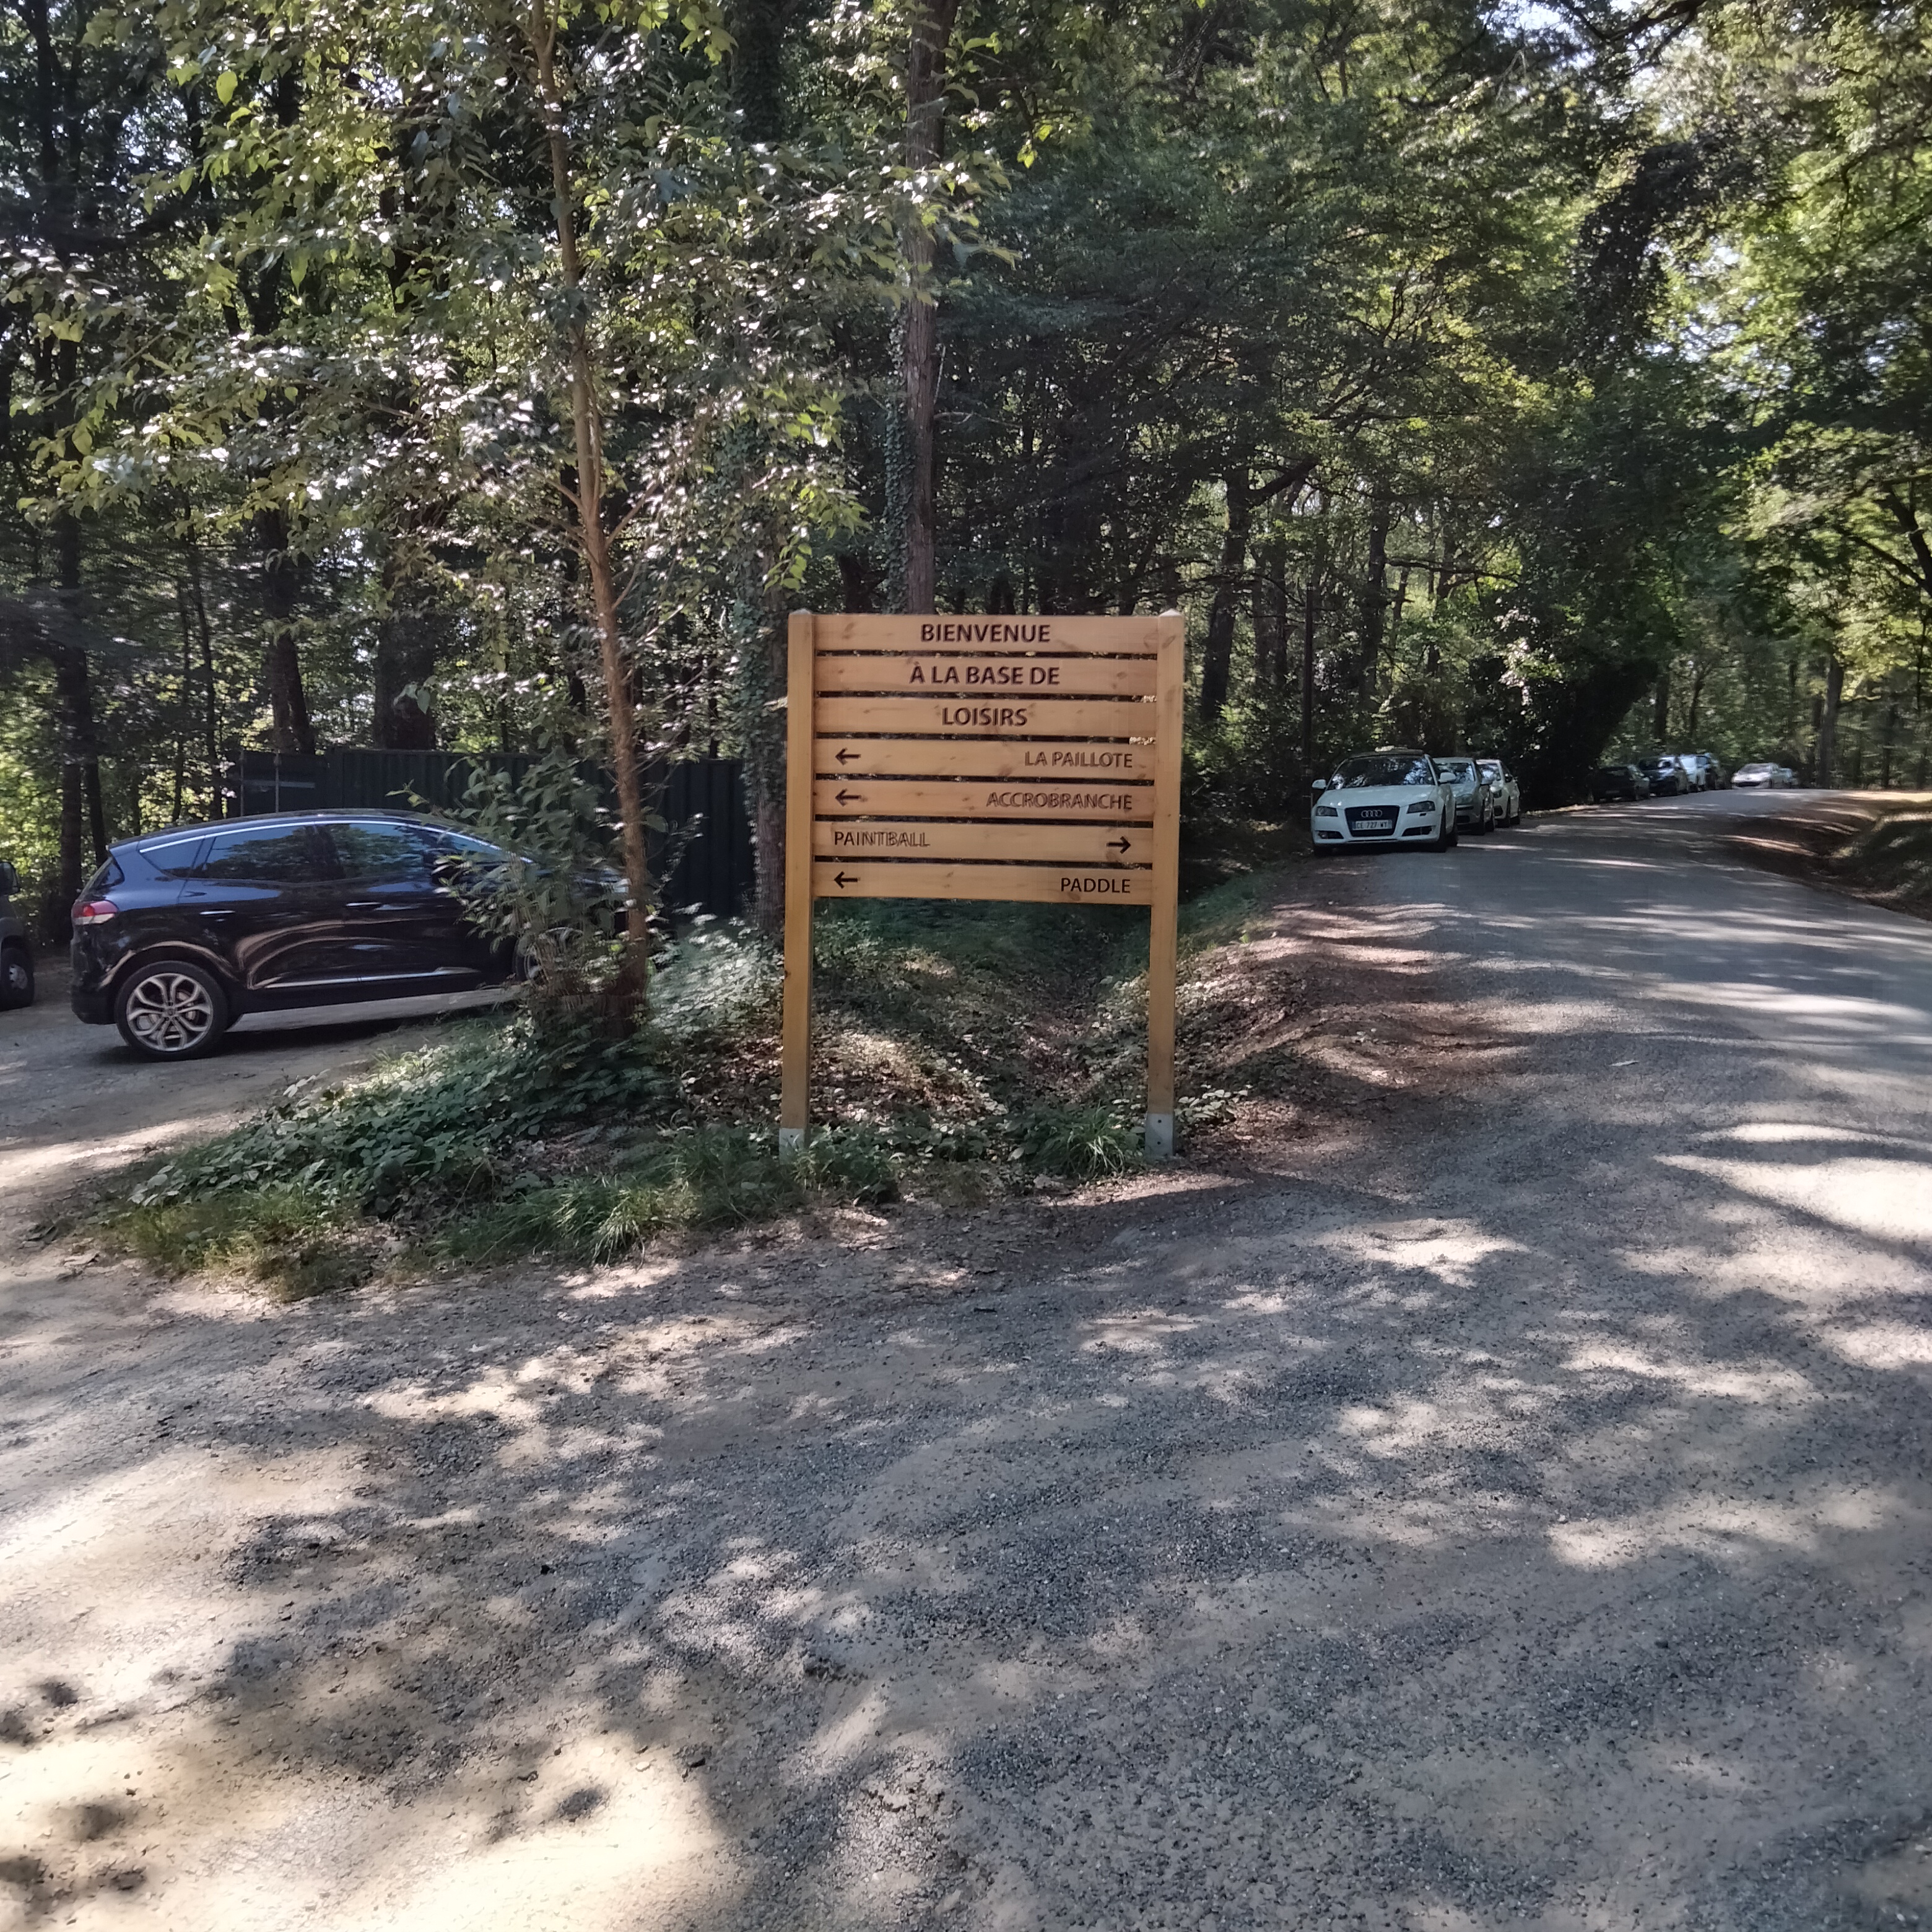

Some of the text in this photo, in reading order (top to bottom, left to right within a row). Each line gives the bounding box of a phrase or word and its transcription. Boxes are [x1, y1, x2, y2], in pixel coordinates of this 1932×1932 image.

[920, 624, 1050, 642] BIENVENUE
[910, 661, 1060, 684] À LA BASE DE
[942, 707, 1027, 726] LOISIRS
[1024, 751, 1133, 768] LA PAILLOTE
[986, 792, 1133, 810] ACCROBRANCHE
[833, 831, 929, 846] PAINTBALL
[1061, 877, 1131, 893] PADDLE
